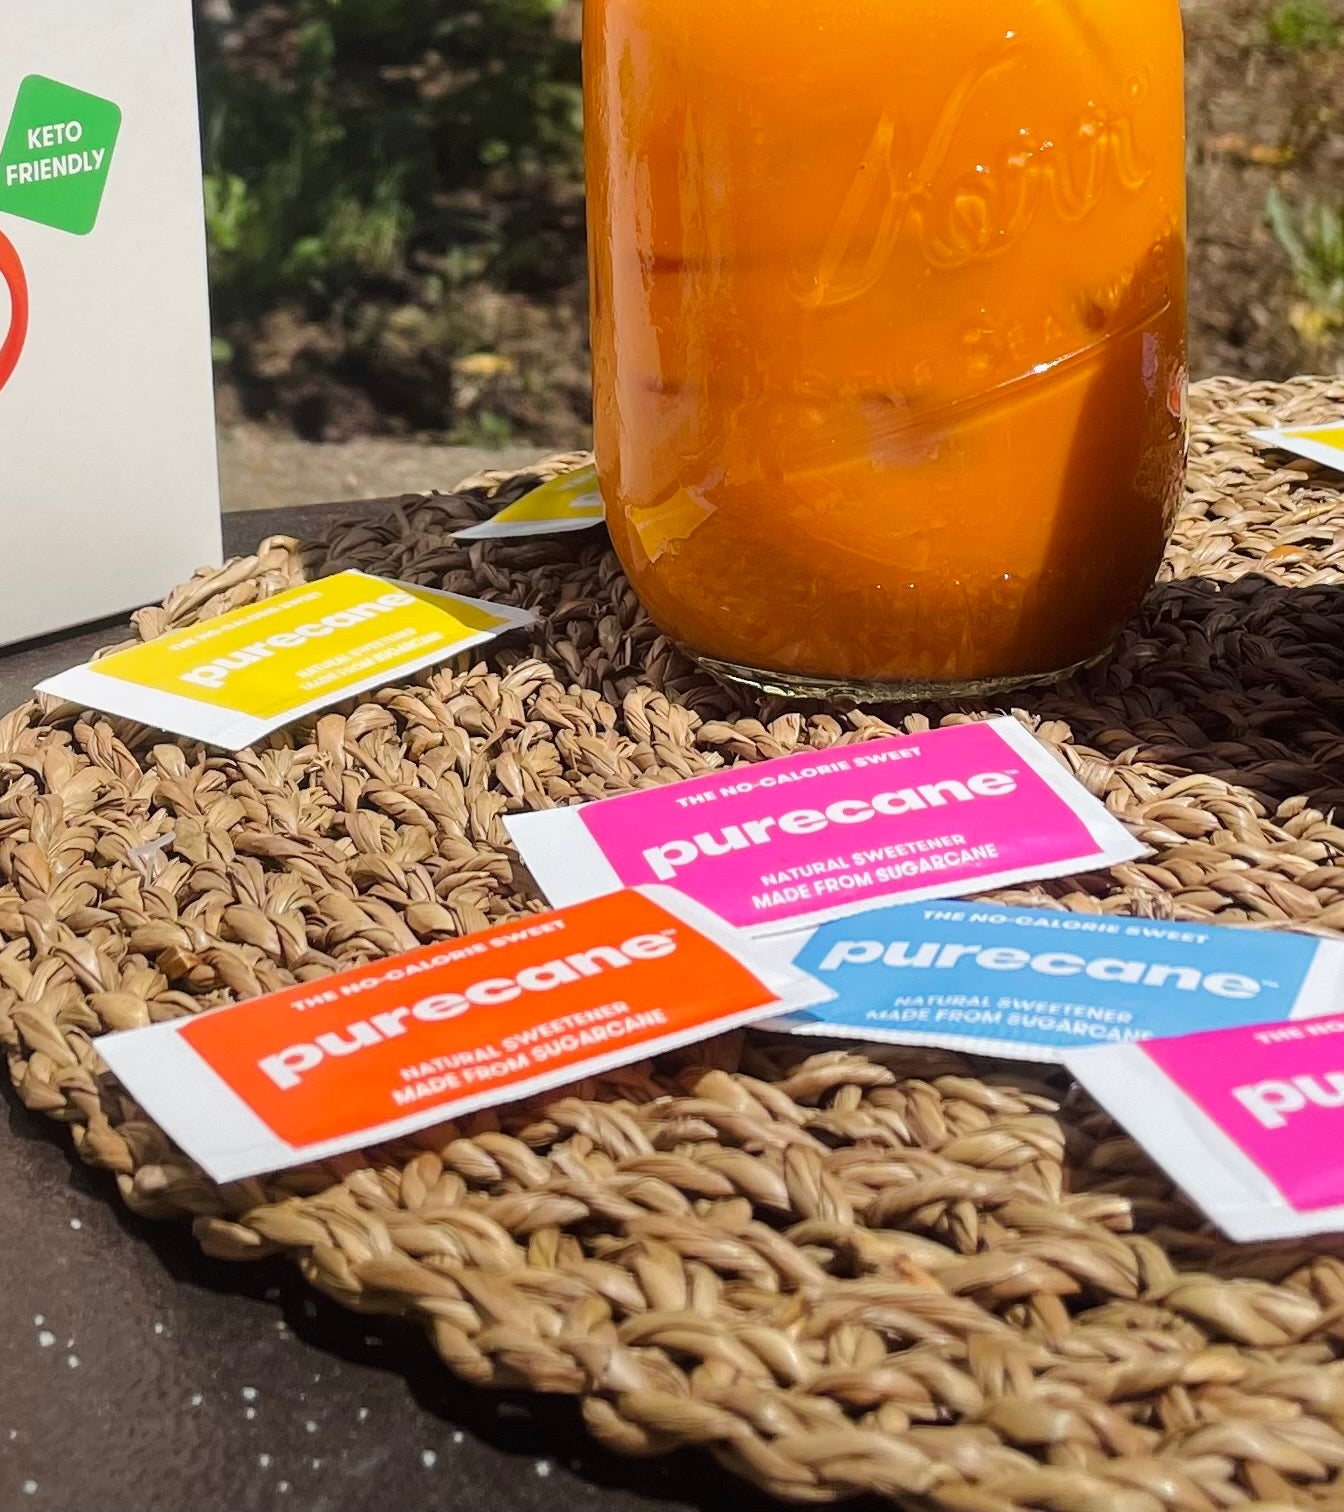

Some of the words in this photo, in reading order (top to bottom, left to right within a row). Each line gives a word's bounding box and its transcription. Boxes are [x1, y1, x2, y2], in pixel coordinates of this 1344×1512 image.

[27, 121, 83, 150] KETO
[6, 148, 106, 187] FRIENDLY
[179, 591, 417, 688] purecane
[675, 789, 718, 808] THE
[720, 760, 851, 798] NO-CALORIE
[853, 746, 922, 769] SWEET
[752, 886, 812, 911] MADE
[814, 872, 873, 899] FROM
[876, 843, 999, 884] SUGARCANE
[760, 856, 849, 887] NATURAL
[851, 833, 966, 866] SWEETENER
[922, 909, 965, 923] THE
[970, 912, 1121, 935] NO-CALORIE
[1124, 925, 1211, 945] SWEET
[291, 990, 337, 1013] THE
[340, 940, 487, 997] NO-CALORIE
[486, 919, 567, 948] SWEET
[865, 1007, 929, 1023] MADE
[933, 1008, 1002, 1025] FROM
[893, 994, 996, 1010] NATURAL
[999, 996, 1133, 1025] SWEETENER
[1254, 1024, 1302, 1045] THE
[392, 1078, 461, 1107] MADE
[462, 1056, 530, 1087] FROM
[533, 1008, 668, 1063] SUGARCANE
[400, 1044, 503, 1082] NATURAL
[503, 1000, 629, 1053] SWEETENER
